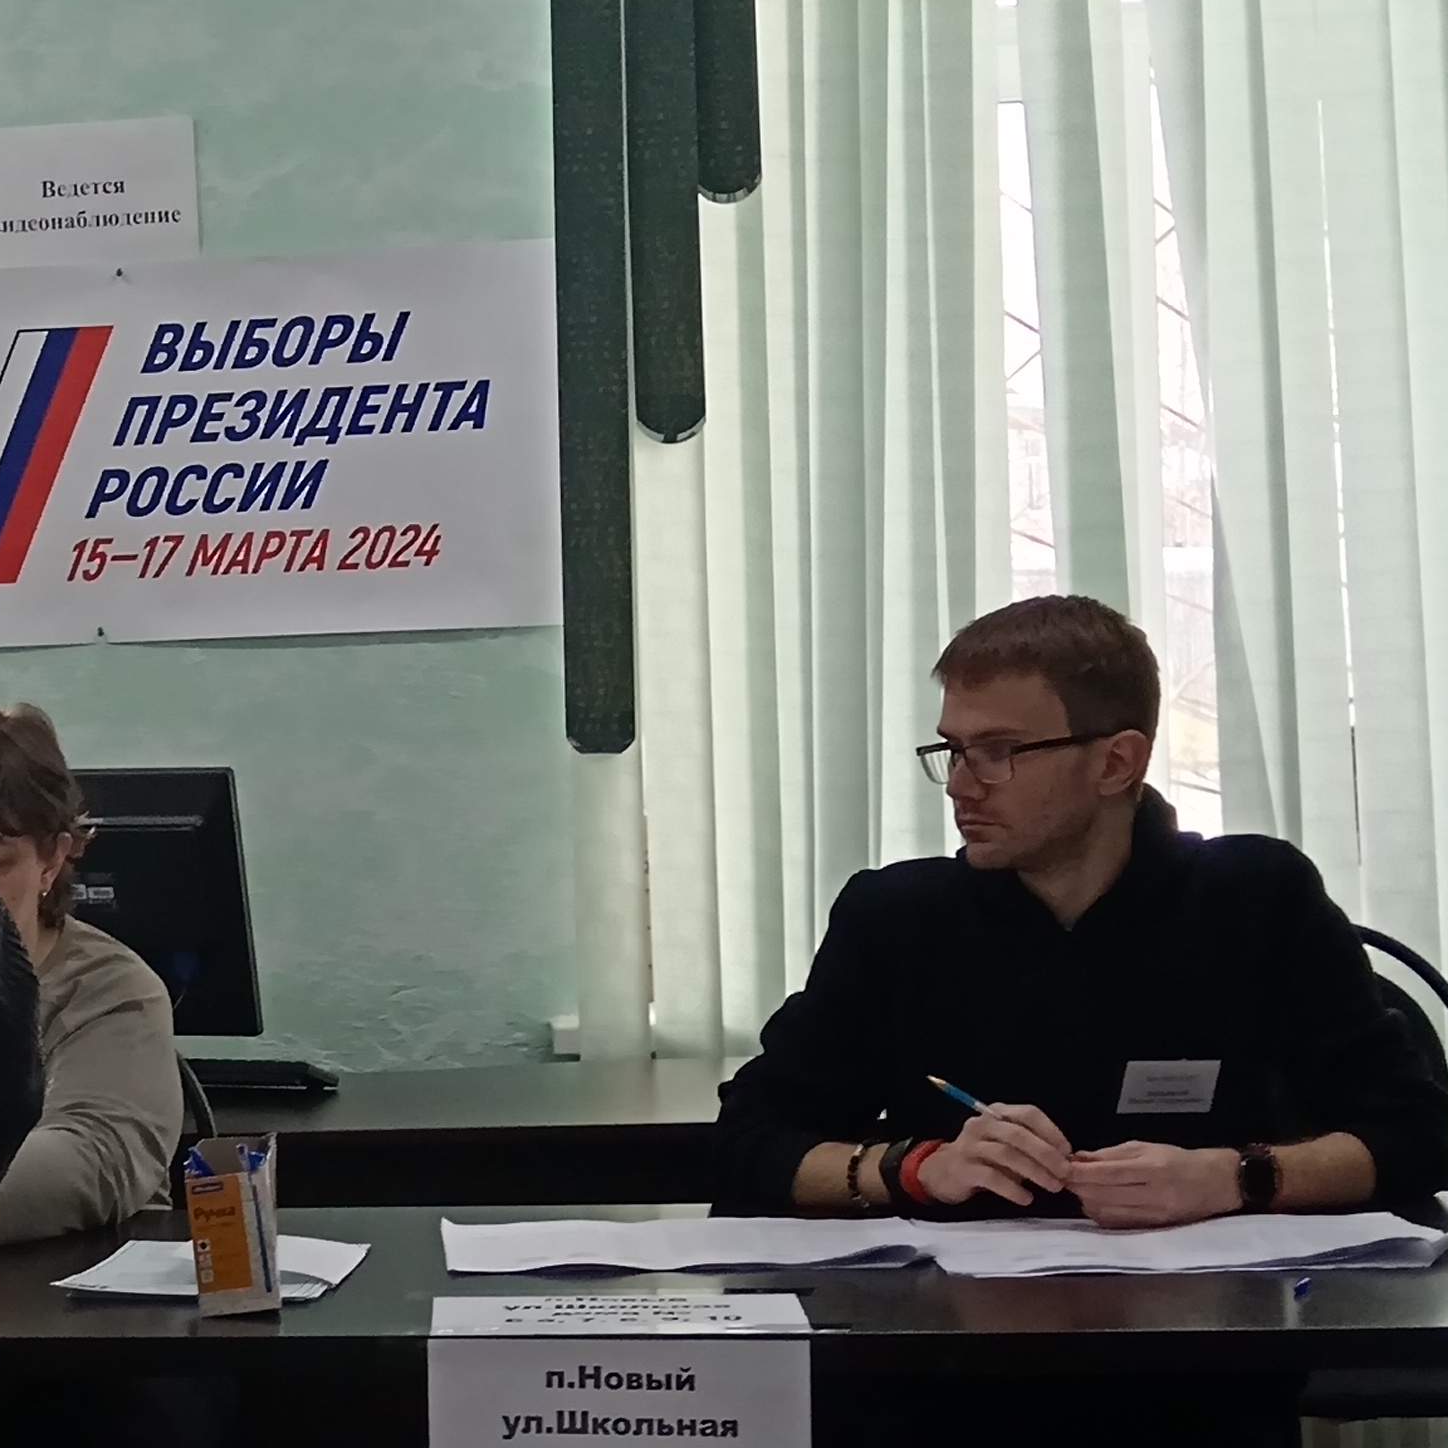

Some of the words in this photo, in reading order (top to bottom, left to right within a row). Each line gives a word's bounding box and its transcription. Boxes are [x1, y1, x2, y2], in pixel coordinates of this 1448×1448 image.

[40, 180, 126, 199] Ведется
[140, 310, 412, 374] ВЫБОРЫ
[112, 379, 491, 447] ПРЕЗИДЕНТА
[84, 458, 329, 520] РОССИИ
[185, 527, 331, 577] МАРТА
[337, 522, 443, 572] 2024
[544, 1365, 697, 1392] п.Новый
[501, 1410, 739, 1440] ул.Школьная
